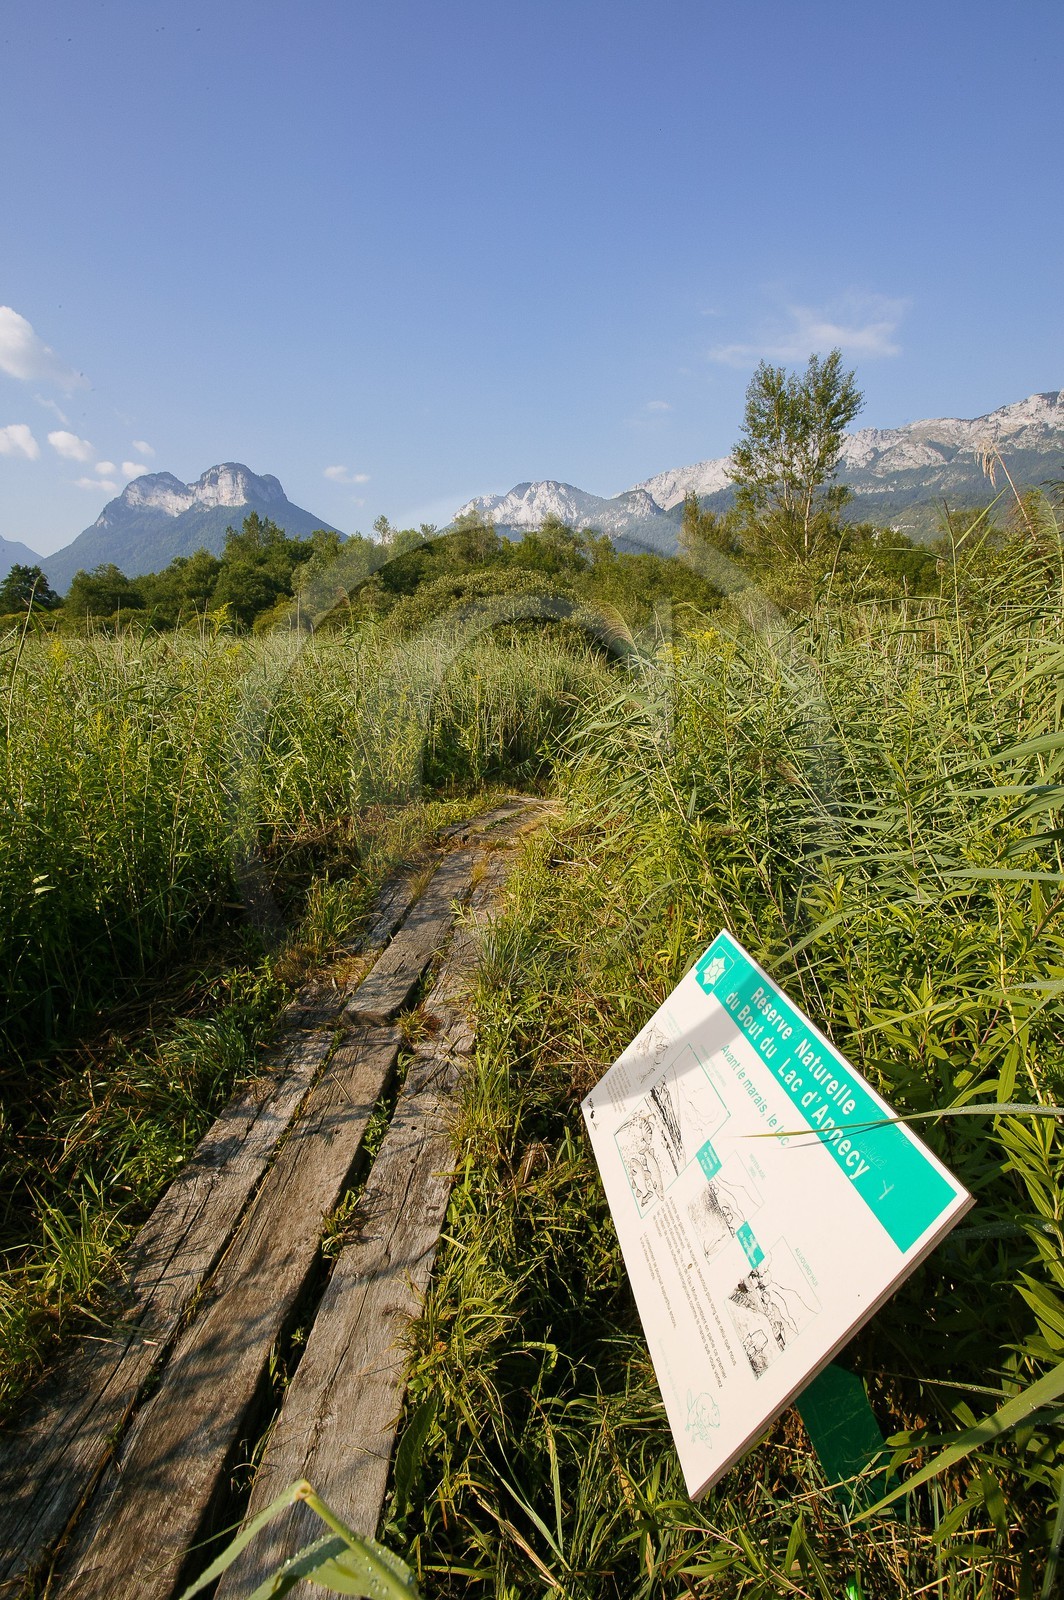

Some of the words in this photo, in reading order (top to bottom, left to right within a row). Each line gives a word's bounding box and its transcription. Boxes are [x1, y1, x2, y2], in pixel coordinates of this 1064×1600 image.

[721, 1044, 741, 1071] Avant
[736, 1067, 746, 1080] le
[766, 1113, 778, 1128] le
[726, 992, 740, 1011] du
[737, 1005, 764, 1040] Bout
[760, 1037, 777, 1059] du
[778, 1058, 803, 1092] Lac
[801, 1091, 870, 1180] d'Annecy
[751, 987, 793, 1040] Réserve
[794, 1038, 856, 1115] Naturelle
